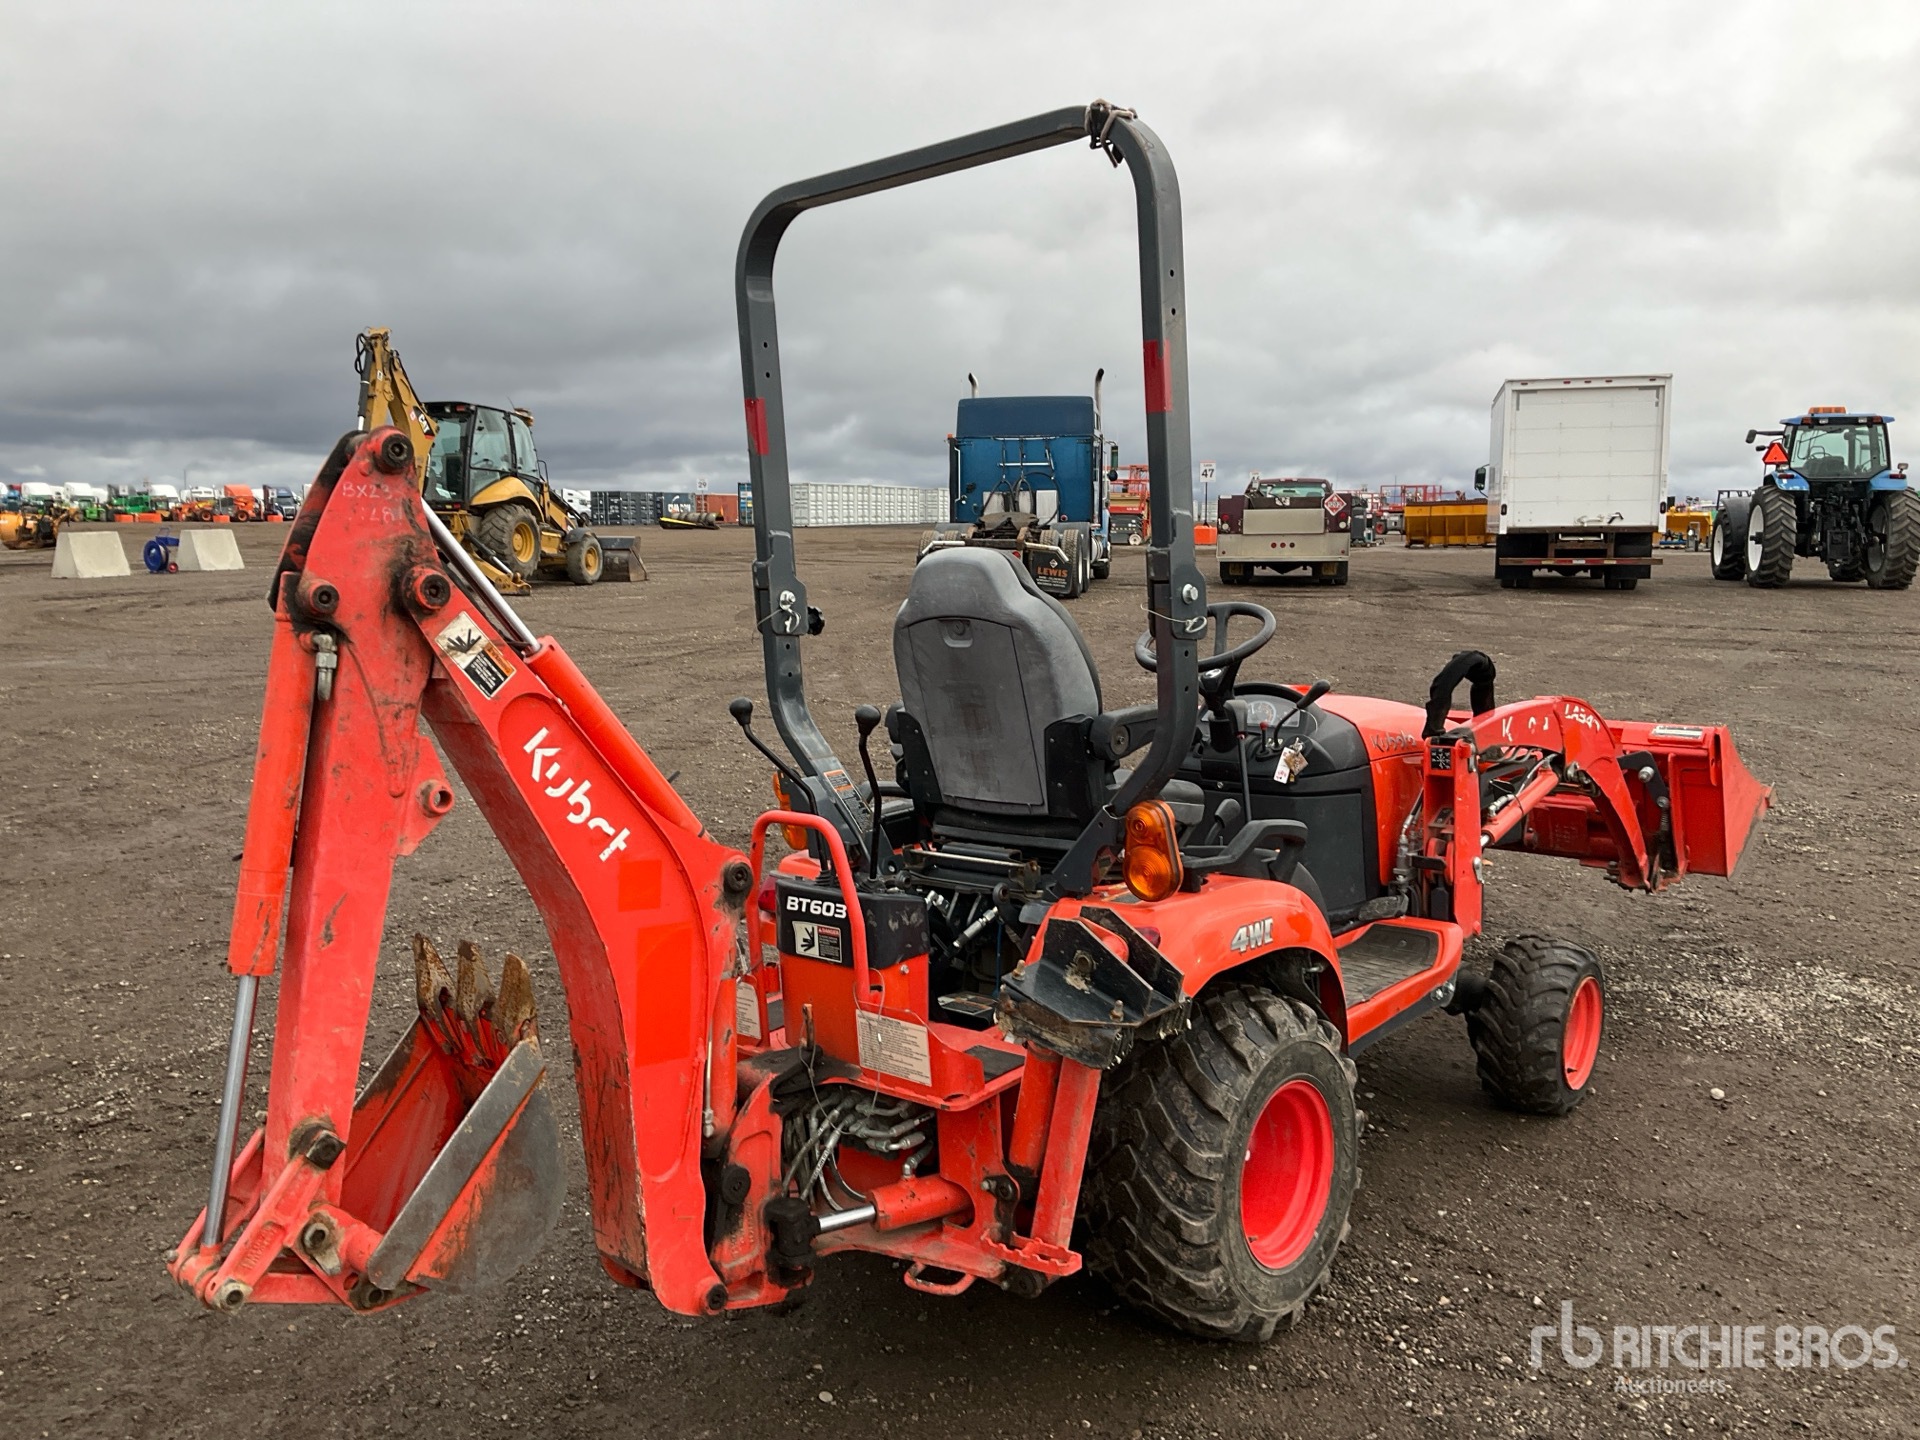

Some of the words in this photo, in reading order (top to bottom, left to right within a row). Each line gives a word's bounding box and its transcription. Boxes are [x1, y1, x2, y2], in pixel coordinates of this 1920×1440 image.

[418, 413, 431, 434] CAT
[1201, 468, 1214, 478] 47
[697, 481, 707, 489] 29
[1036, 566, 1068, 578] LEWIS
[786, 895, 848, 919] BT603
